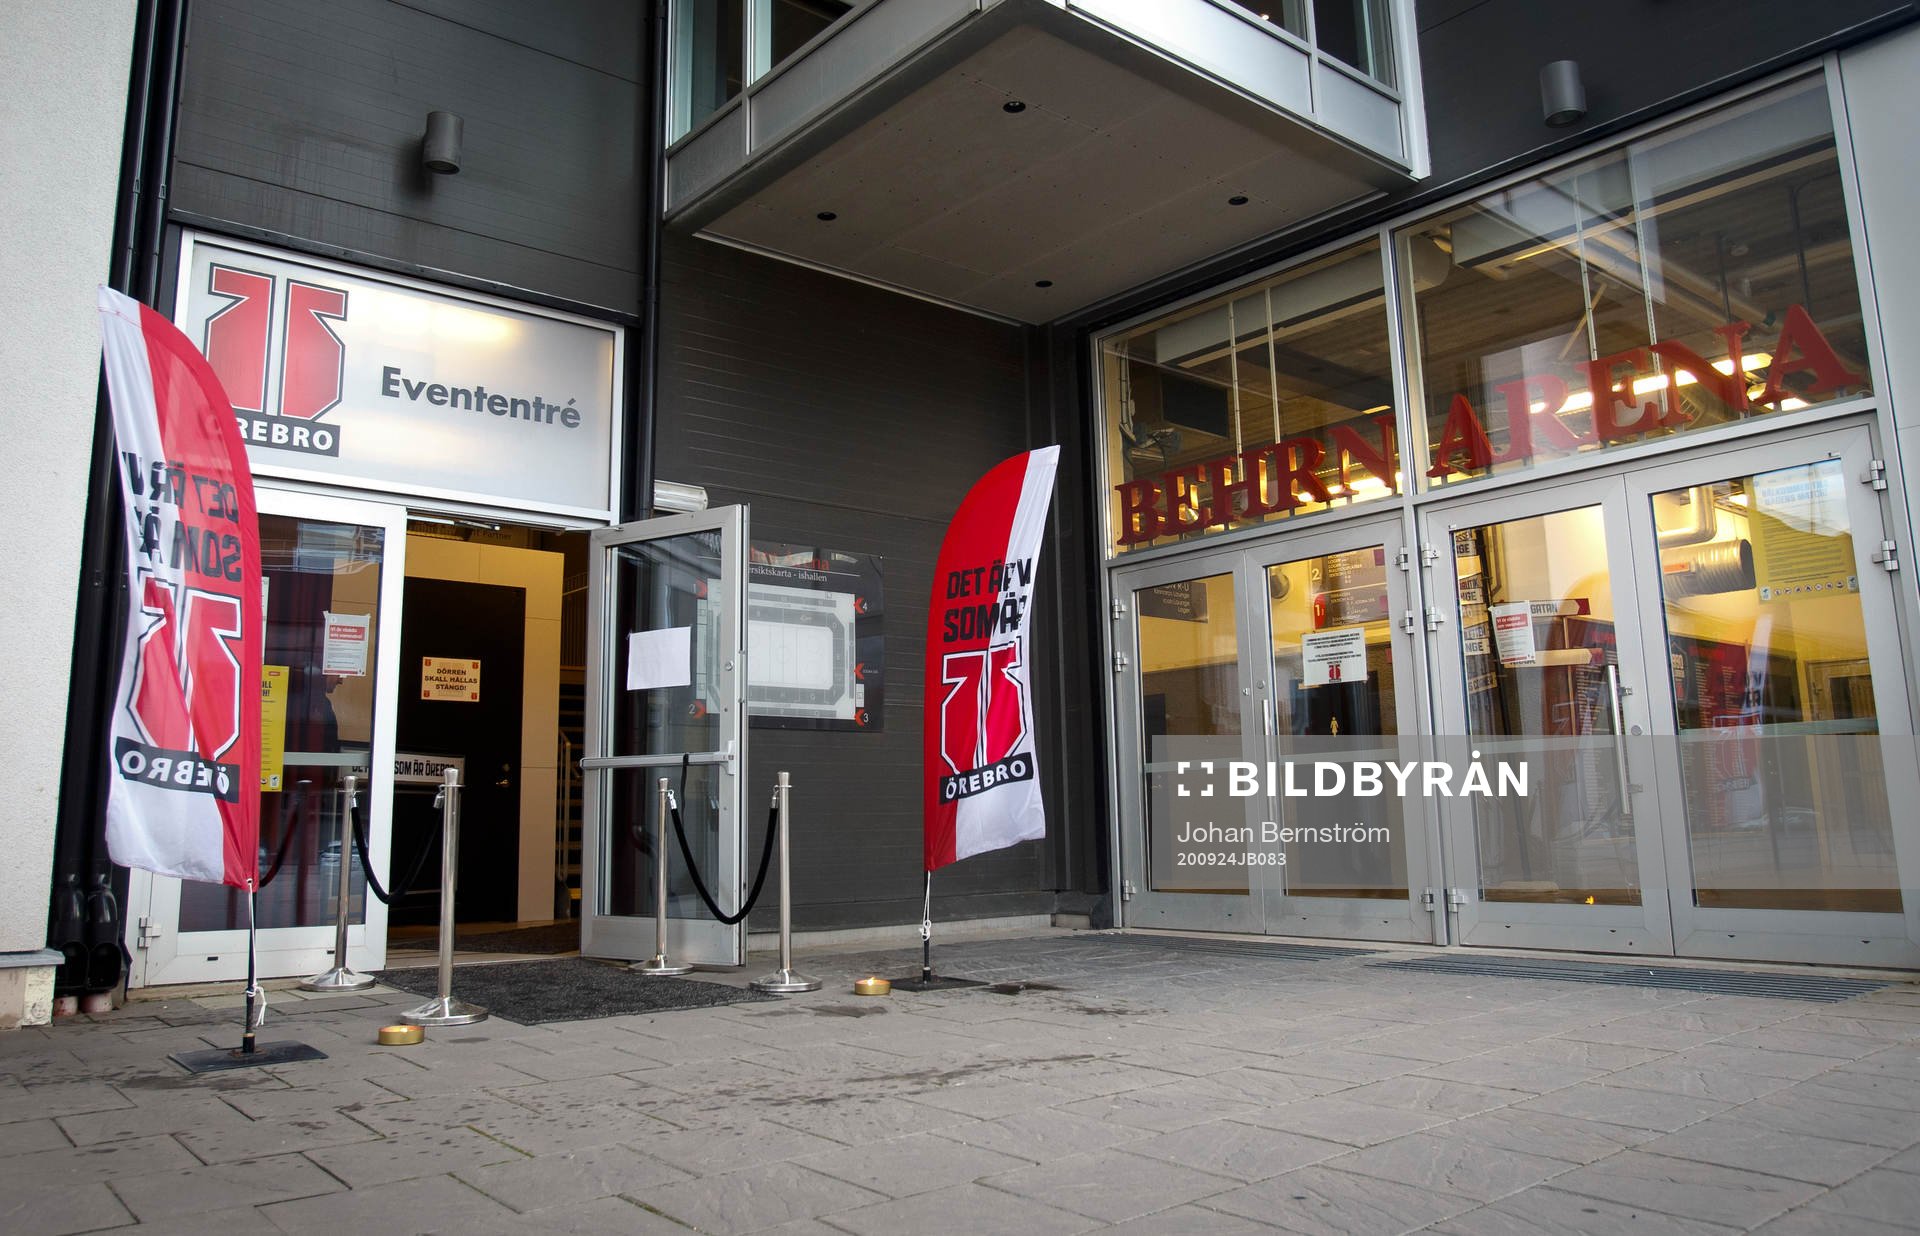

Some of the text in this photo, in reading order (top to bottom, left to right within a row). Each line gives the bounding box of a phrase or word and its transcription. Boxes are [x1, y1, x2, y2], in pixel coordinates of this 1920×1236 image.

[382, 366, 580, 429] Evententré
[236, 417, 333, 451] REBRO
[1115, 304, 1863, 545] BEHRN ARENA
[798, 571, 828, 582] ishallen
[946, 567, 986, 599] DET
[1312, 568, 1321, 580] 2
[435, 683, 467, 691] STÄNGD!
[449, 676, 478, 684] HÅLLAS
[394, 760, 412, 775] SOM
[413, 760, 424, 776] ÄR
[945, 760, 1027, 799] ÖREBRO
